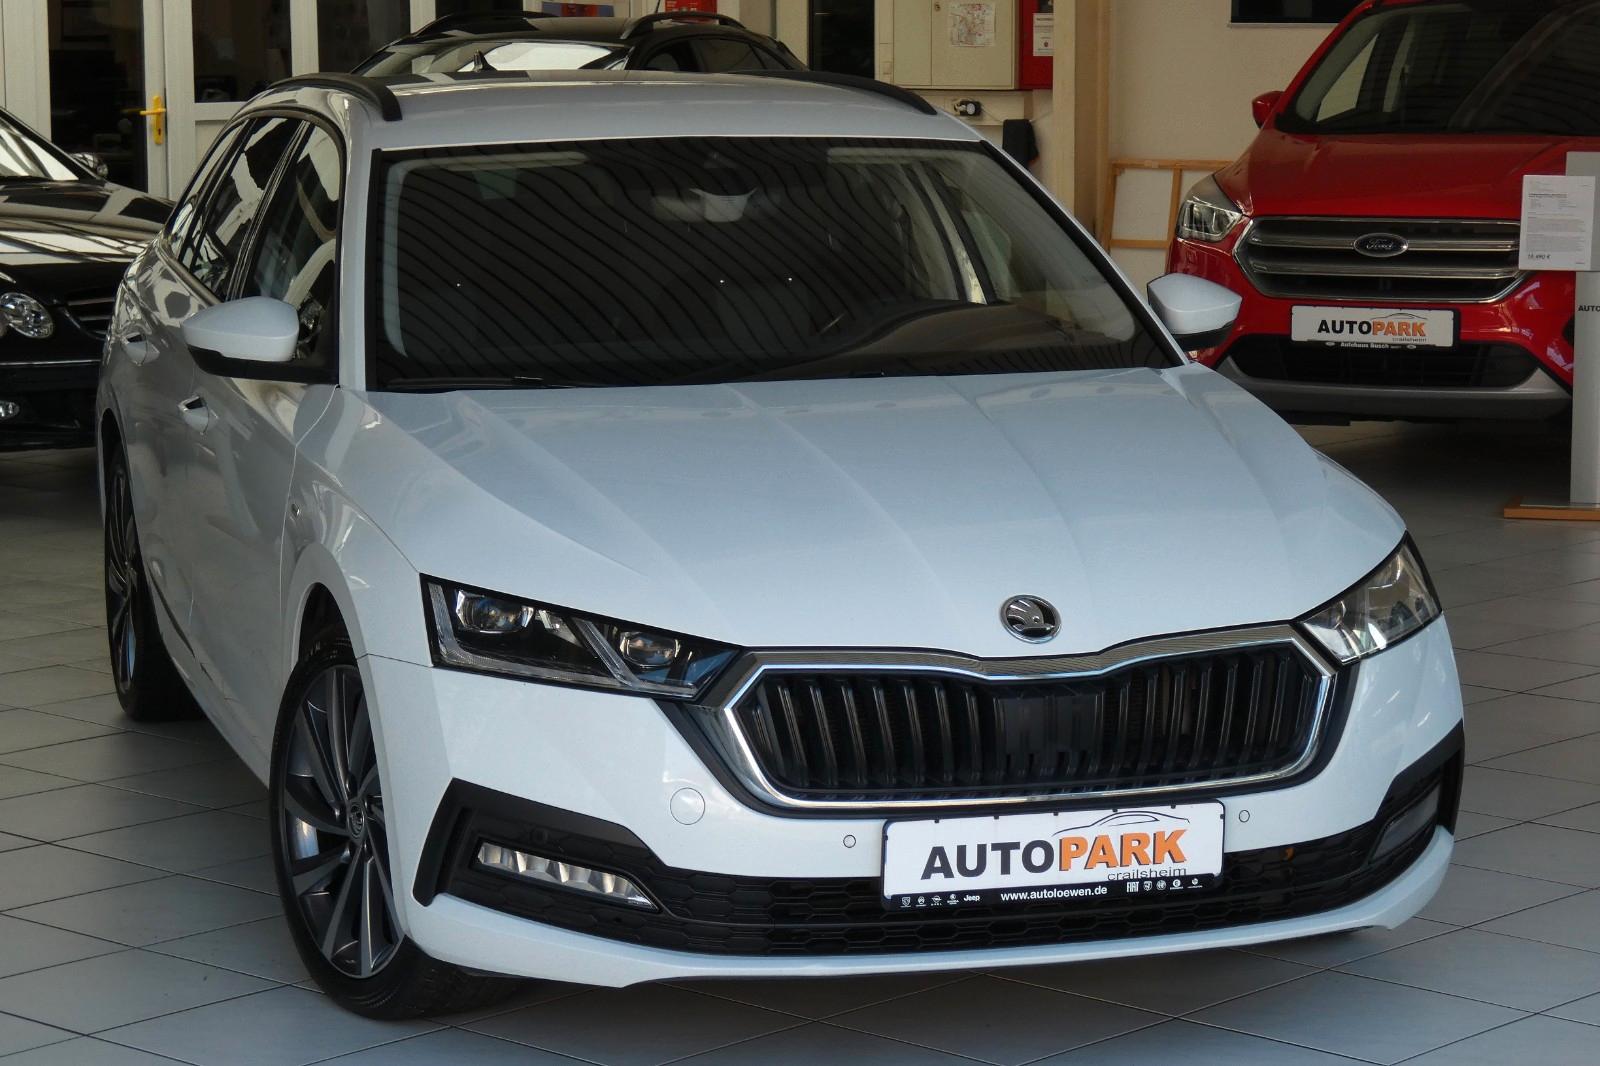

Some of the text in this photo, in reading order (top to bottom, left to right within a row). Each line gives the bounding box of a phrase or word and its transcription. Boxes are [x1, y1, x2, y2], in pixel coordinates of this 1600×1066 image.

[1365, 239, 1394, 251] Ford
[1317, 319, 1427, 338] AUTOPARK
[920, 829, 1188, 881] AUTOPARK
[1107, 866, 1187, 881] crailsheim
[1000, 885, 1108, 902] www.autoloewen.de
[1126, 881, 1139, 893] FIAT
[963, 894, 981, 902] Jeep
